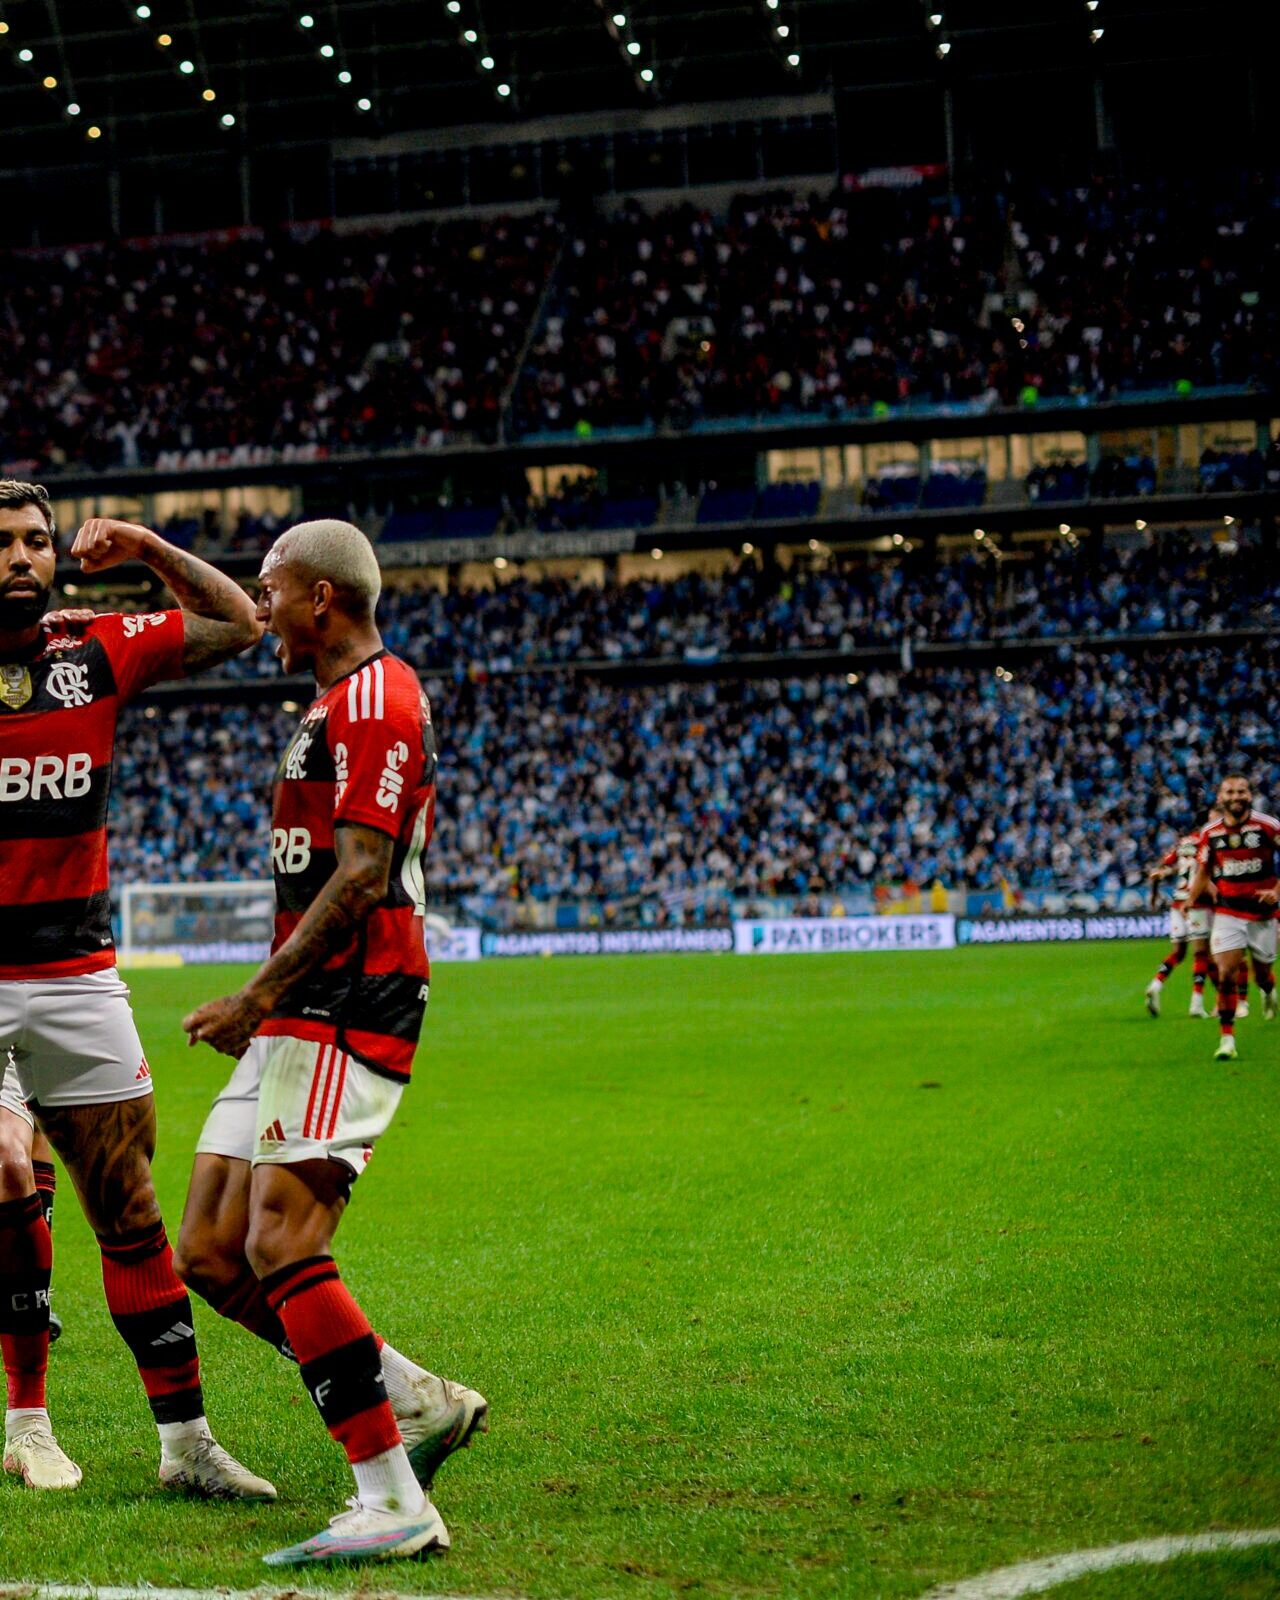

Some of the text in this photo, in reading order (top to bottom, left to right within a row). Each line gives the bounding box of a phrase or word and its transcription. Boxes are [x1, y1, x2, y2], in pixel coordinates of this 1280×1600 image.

[270, 827, 312, 874] RB
[771, 922, 942, 946] PAYBROKERS
[11, 1289, 50, 1312] CR
